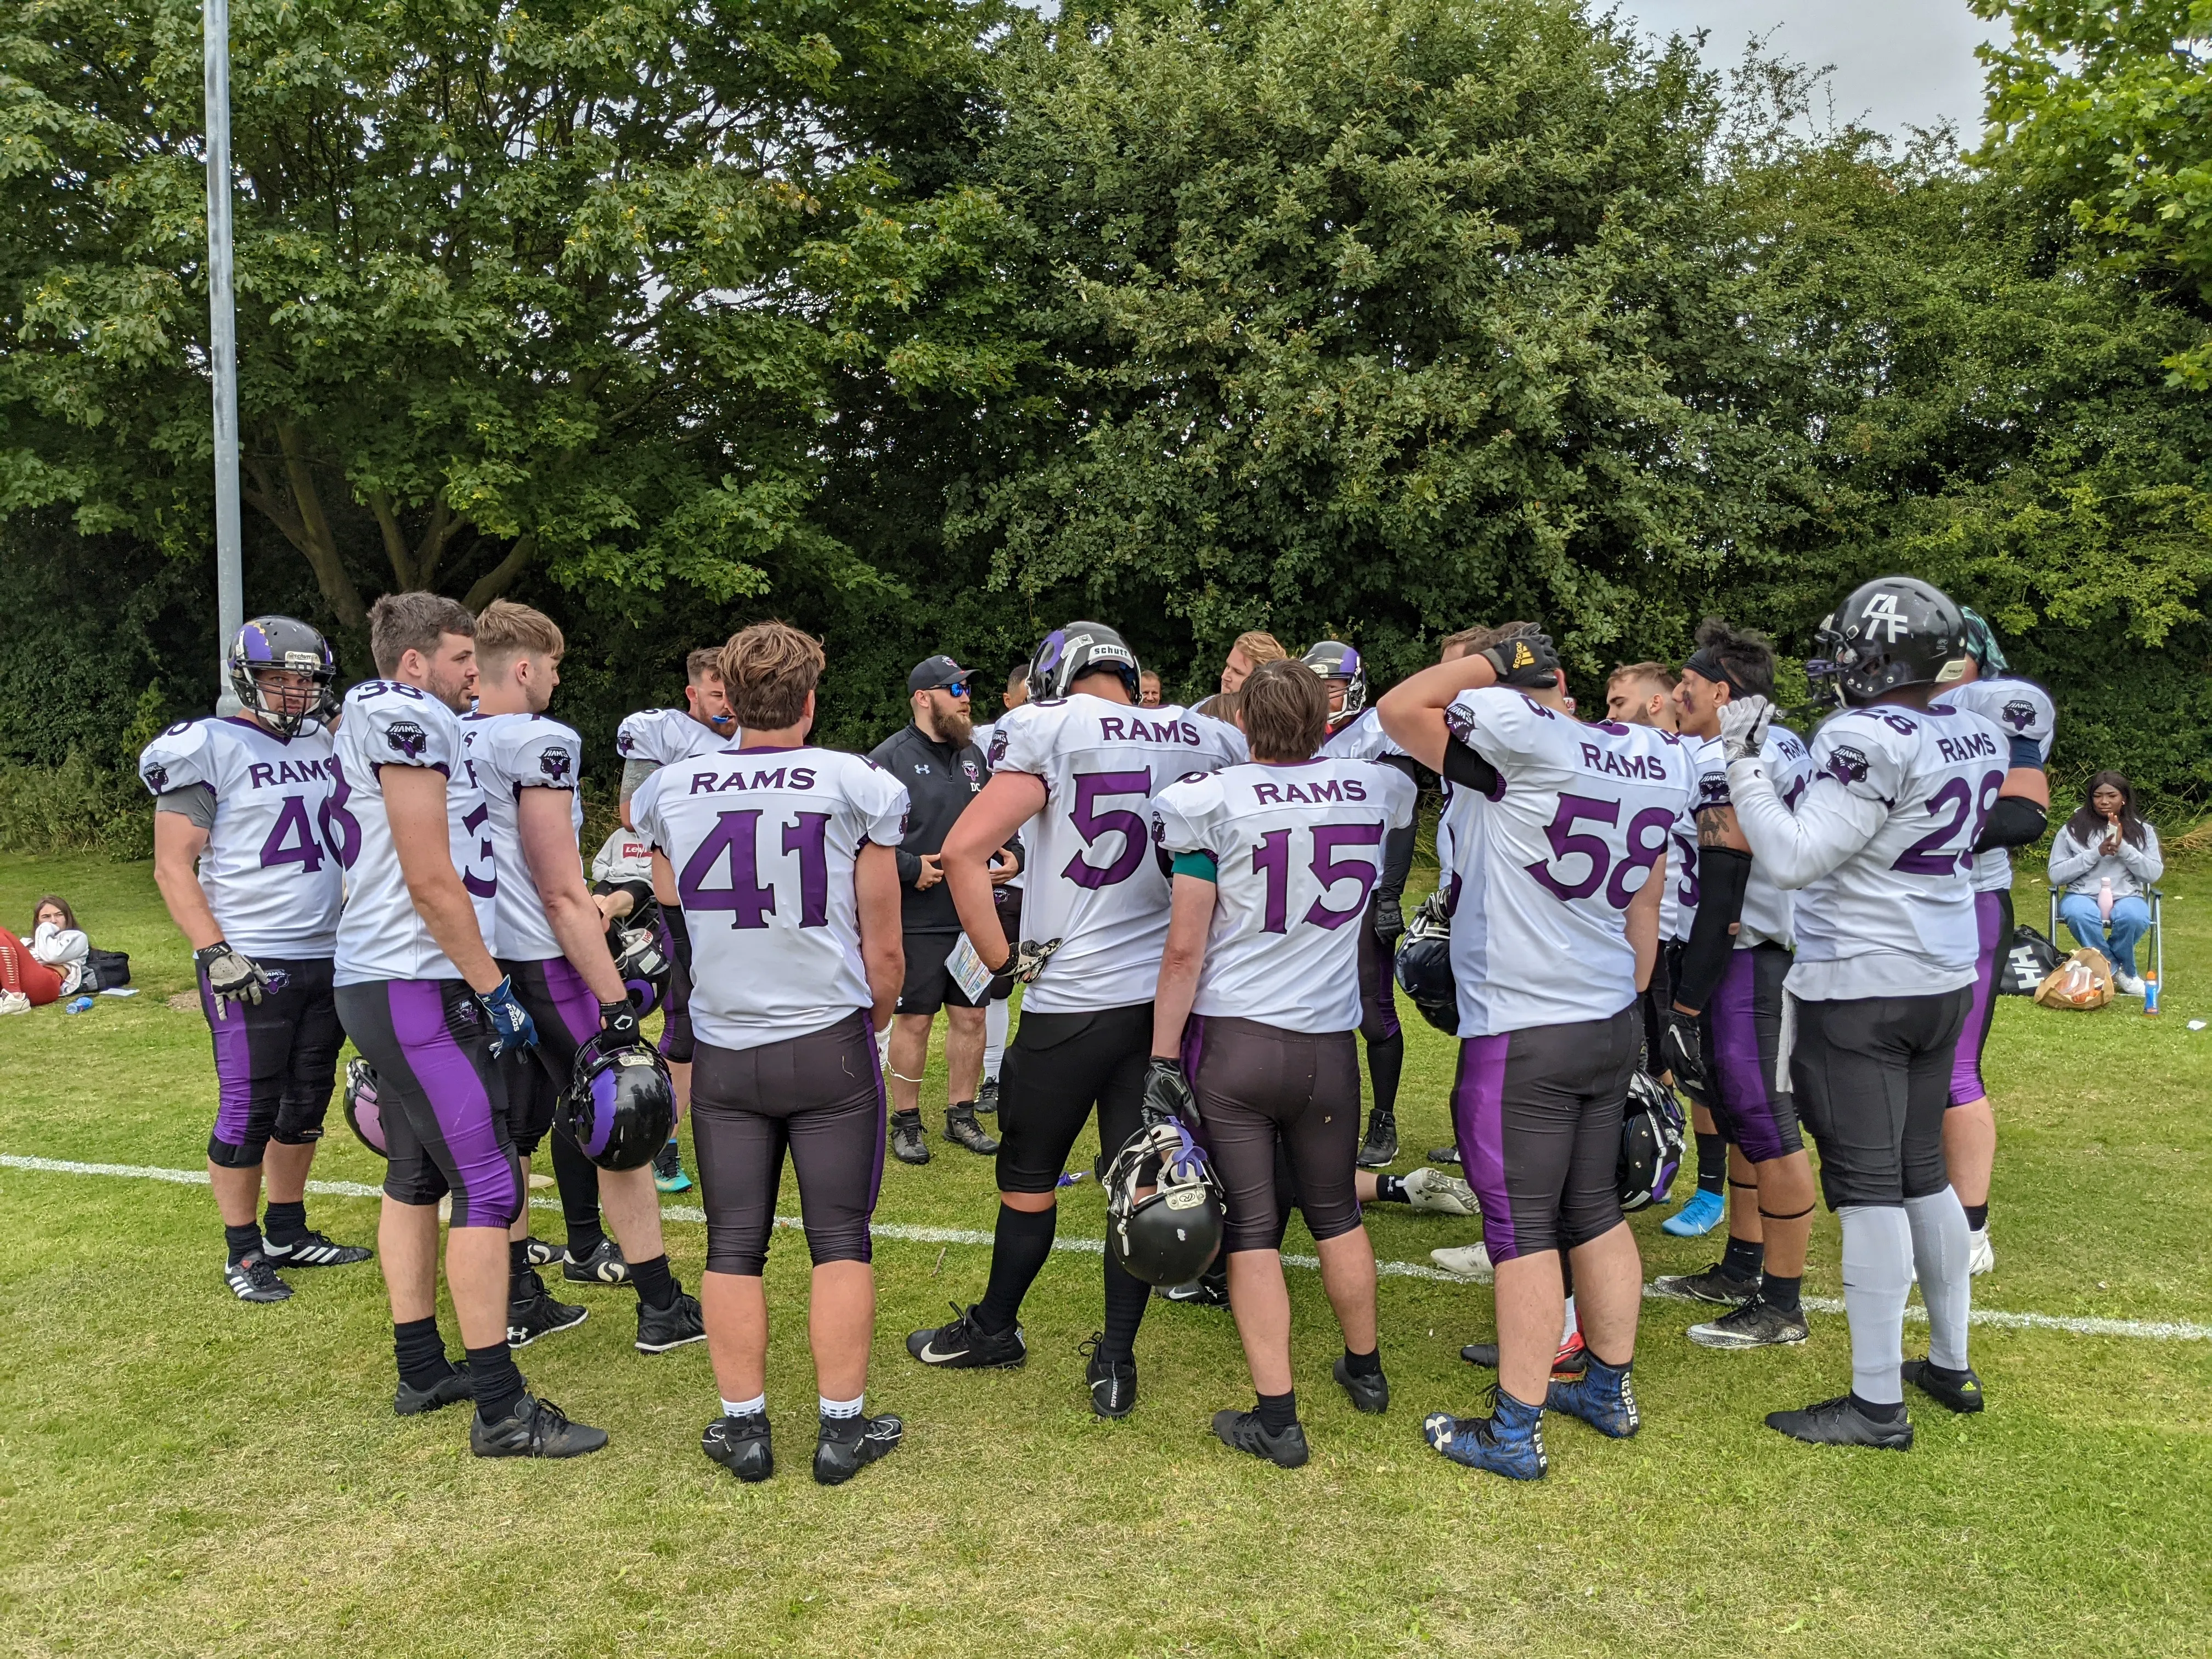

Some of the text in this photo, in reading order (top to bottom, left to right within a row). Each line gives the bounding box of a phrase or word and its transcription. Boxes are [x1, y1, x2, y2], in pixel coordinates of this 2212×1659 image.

[1094, 646, 1128, 657] schutt
[1513, 641, 1522, 669] adidas
[389, 725, 422, 733] RAMS
[1099, 717, 1200, 746] RAMS
[1580, 742, 1666, 781] RAMS
[1936, 732, 1996, 763] RAMS
[689, 768, 817, 795] RAMS
[970, 782, 981, 792] DC
[1252, 780, 1367, 805] RAMS
[1060, 765, 1200, 890] 5
[1525, 792, 1674, 909] 58
[678, 809, 832, 929] 41
[1252, 819, 1385, 935] 15
[505, 1003, 520, 1032] adidas
[1621, 1372, 1638, 1426] ARMOUR
